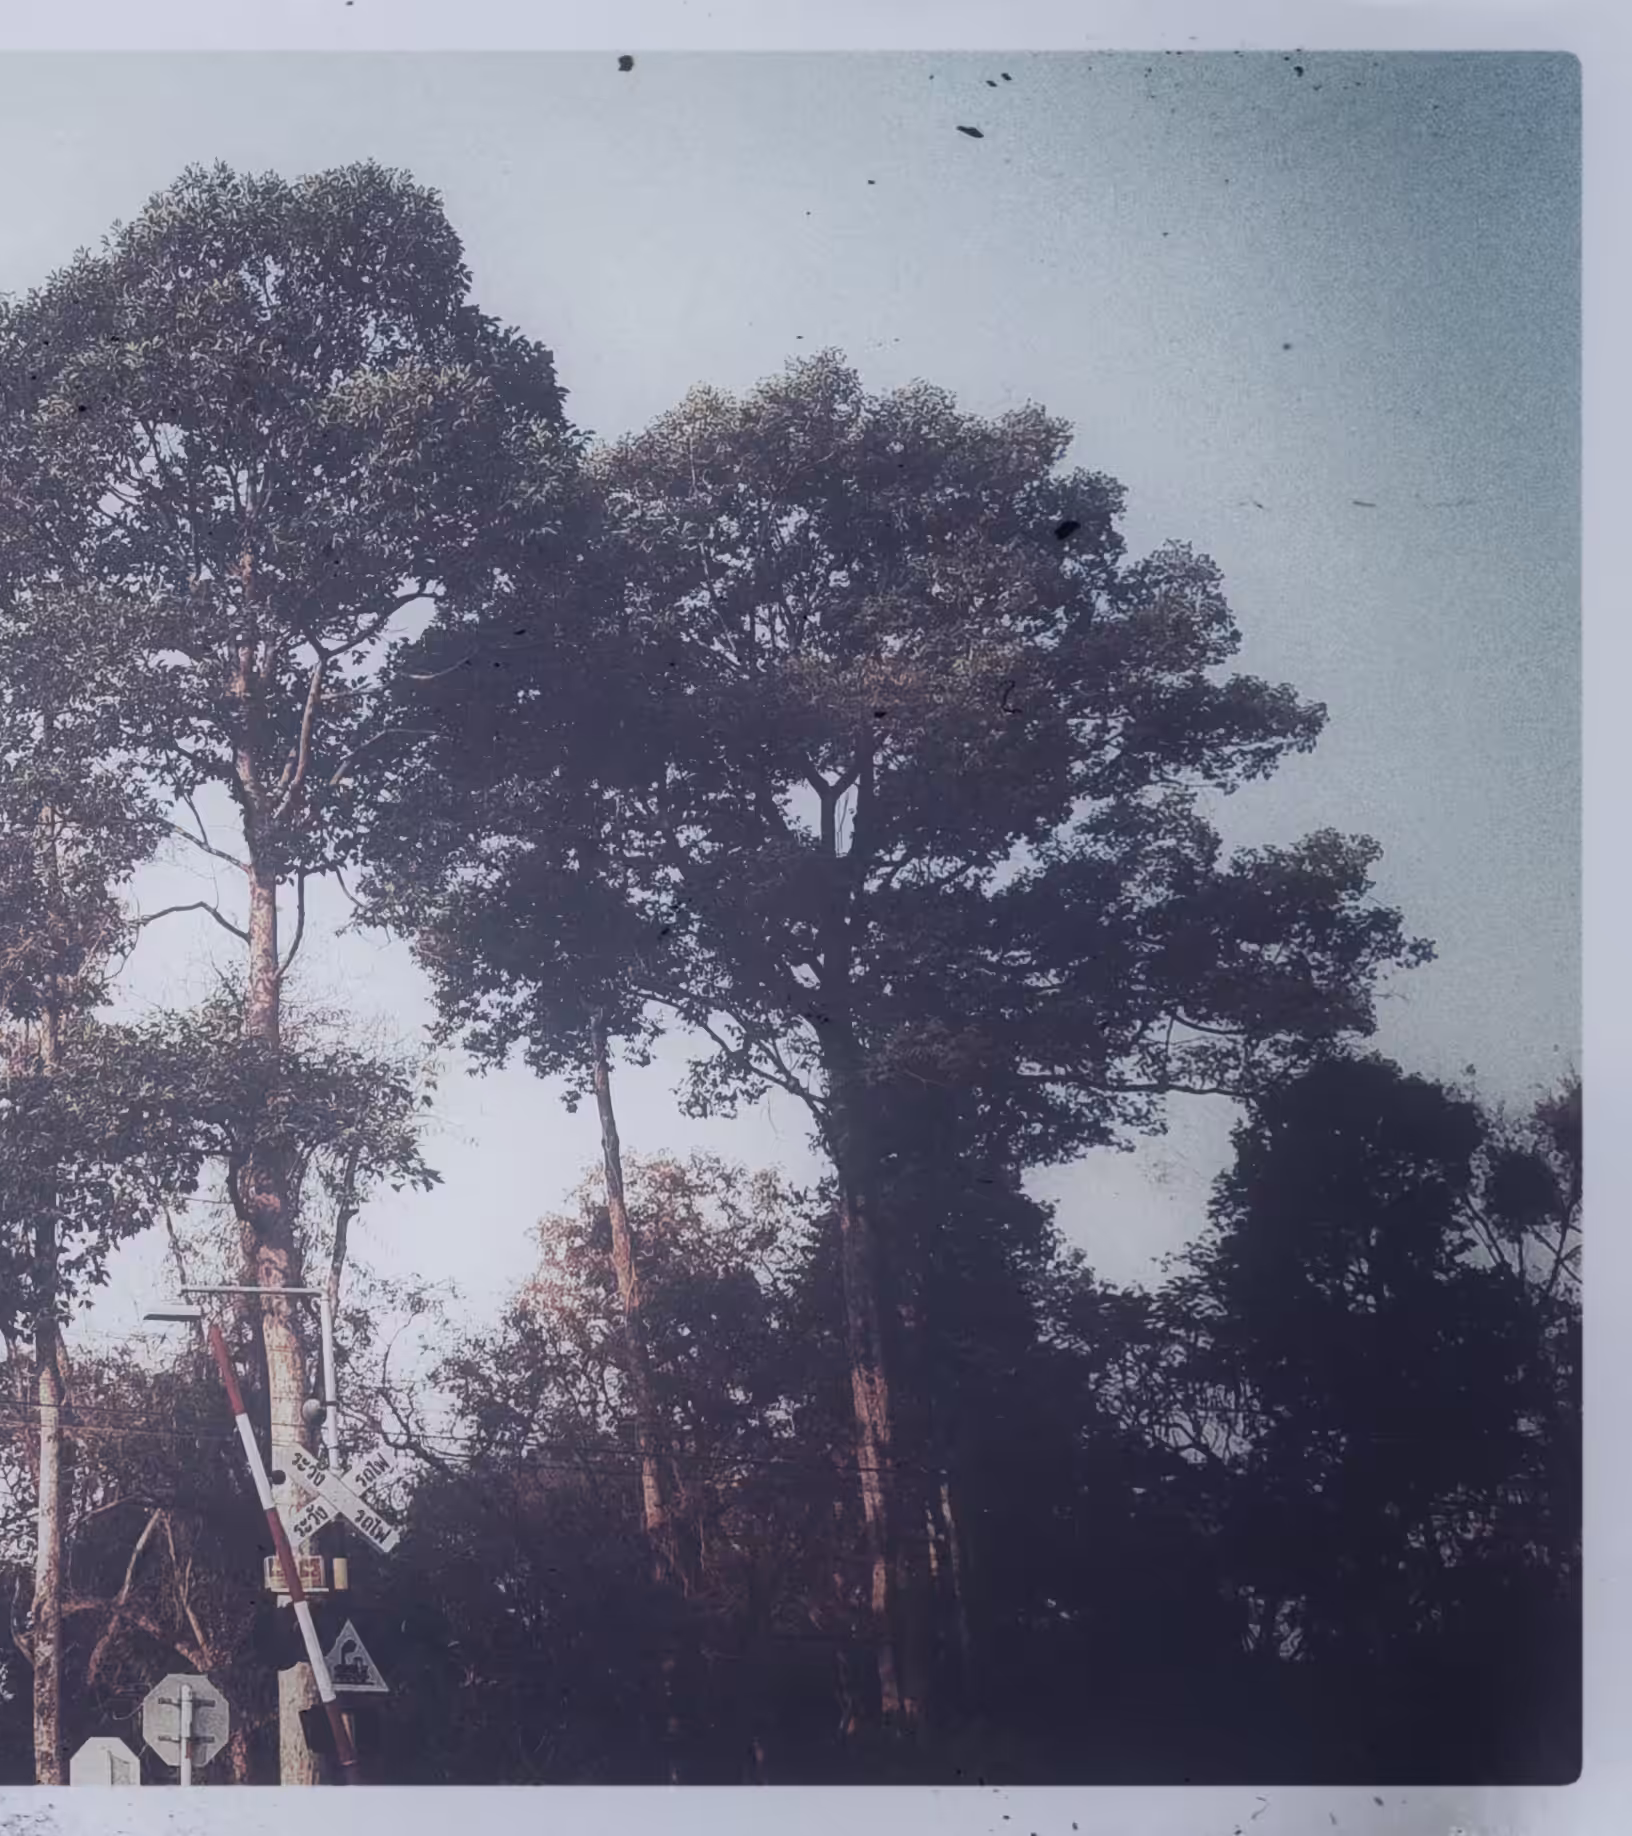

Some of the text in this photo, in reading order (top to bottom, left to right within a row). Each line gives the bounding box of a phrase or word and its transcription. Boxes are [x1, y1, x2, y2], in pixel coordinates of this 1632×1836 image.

[291, 1452, 392, 1545] ระวัง รถไฟ
[293, 1451, 391, 1538] ระวัง รถไฟ
